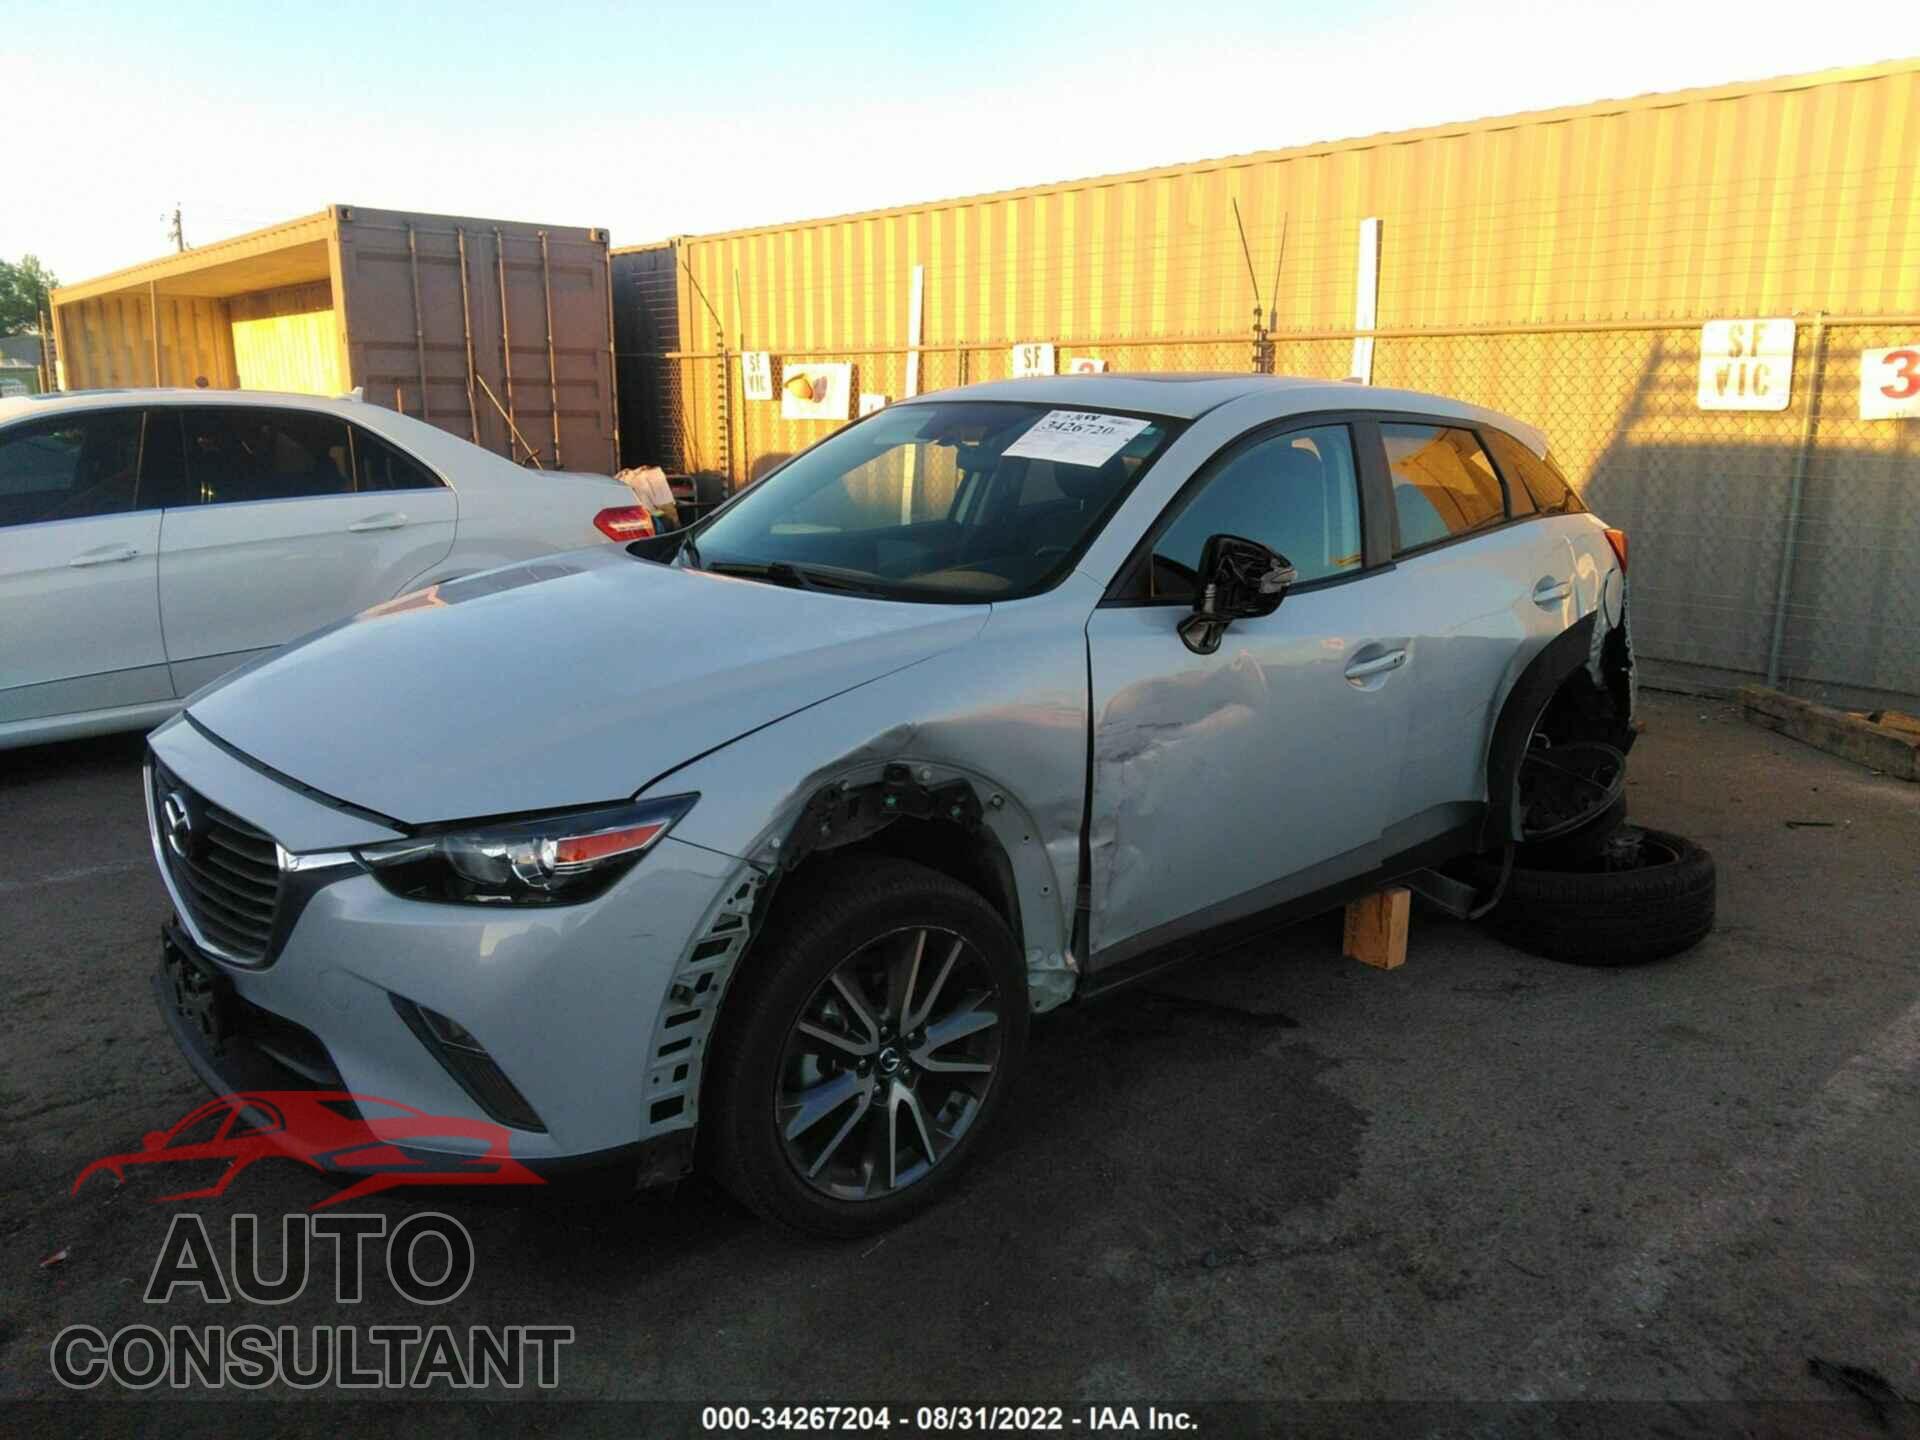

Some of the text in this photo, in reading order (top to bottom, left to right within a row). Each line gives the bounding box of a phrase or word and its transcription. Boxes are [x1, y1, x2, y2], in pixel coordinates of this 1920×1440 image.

[1023, 346, 1042, 369] SF
[1728, 323, 1768, 358] SF
[1880, 350, 1920, 399] 3
